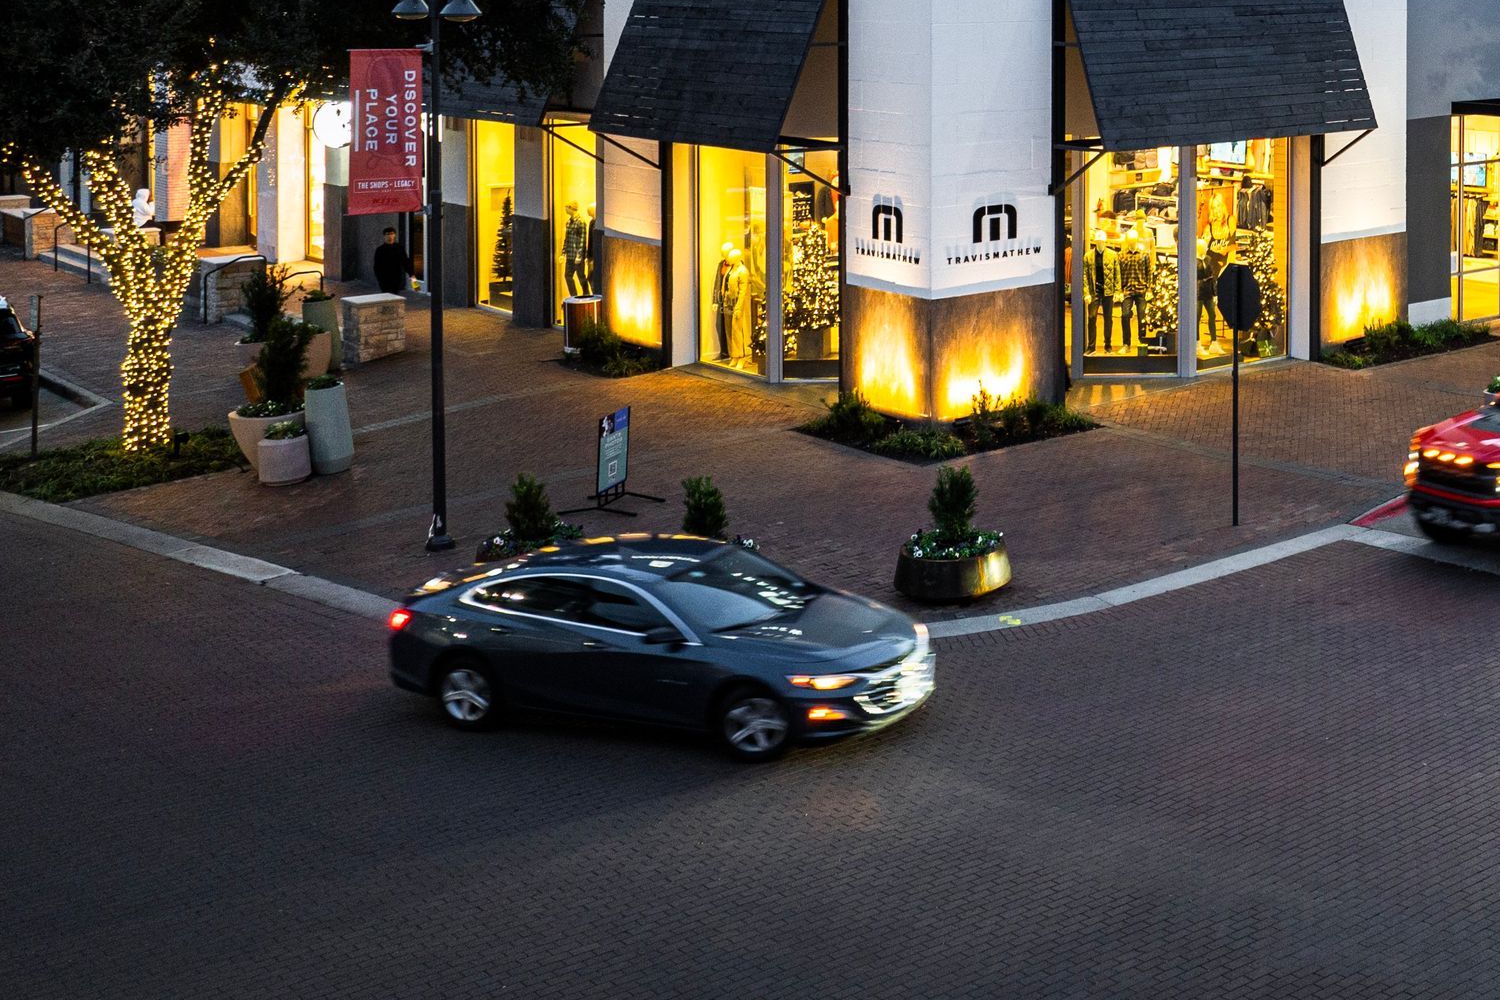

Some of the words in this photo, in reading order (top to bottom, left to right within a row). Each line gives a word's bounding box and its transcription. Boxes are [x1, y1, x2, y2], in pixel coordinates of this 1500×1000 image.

[365, 88, 379, 152] PLACE
[385, 93, 399, 145] YOUR
[404, 69, 417, 167] DISCOVER
[357, 181, 369, 190] THE
[394, 179, 416, 189] LEGACY
[855, 246, 921, 265] TRAVISMATHEW
[946, 246, 1042, 265] TRAVISMATHEW
